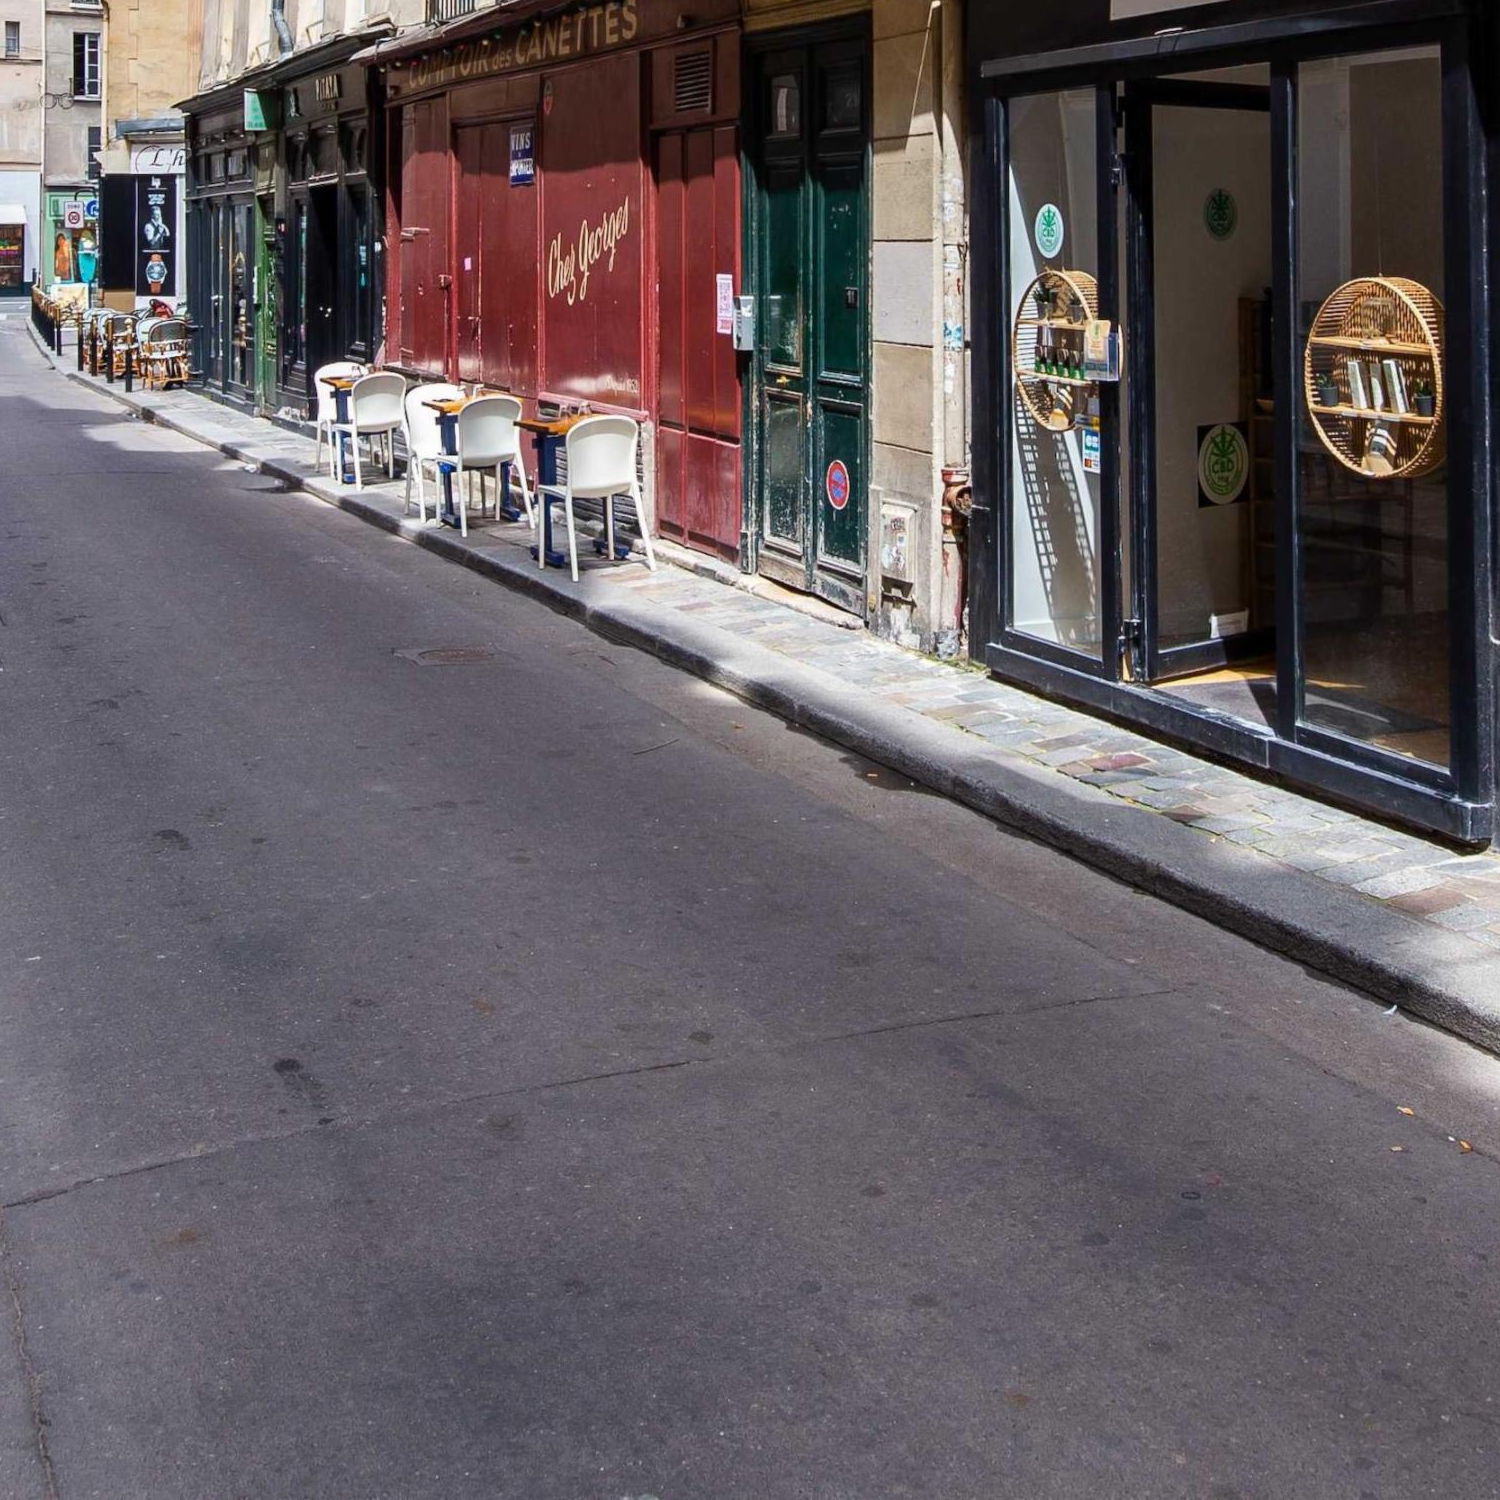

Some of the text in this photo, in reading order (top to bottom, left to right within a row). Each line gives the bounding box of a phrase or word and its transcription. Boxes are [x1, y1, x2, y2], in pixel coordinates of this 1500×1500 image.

[408, 42, 489, 88] COMPTOIR
[492, 48, 512, 69] des
[510, 132, 531, 152] VINS
[549, 196, 629, 306] Chez Georges
